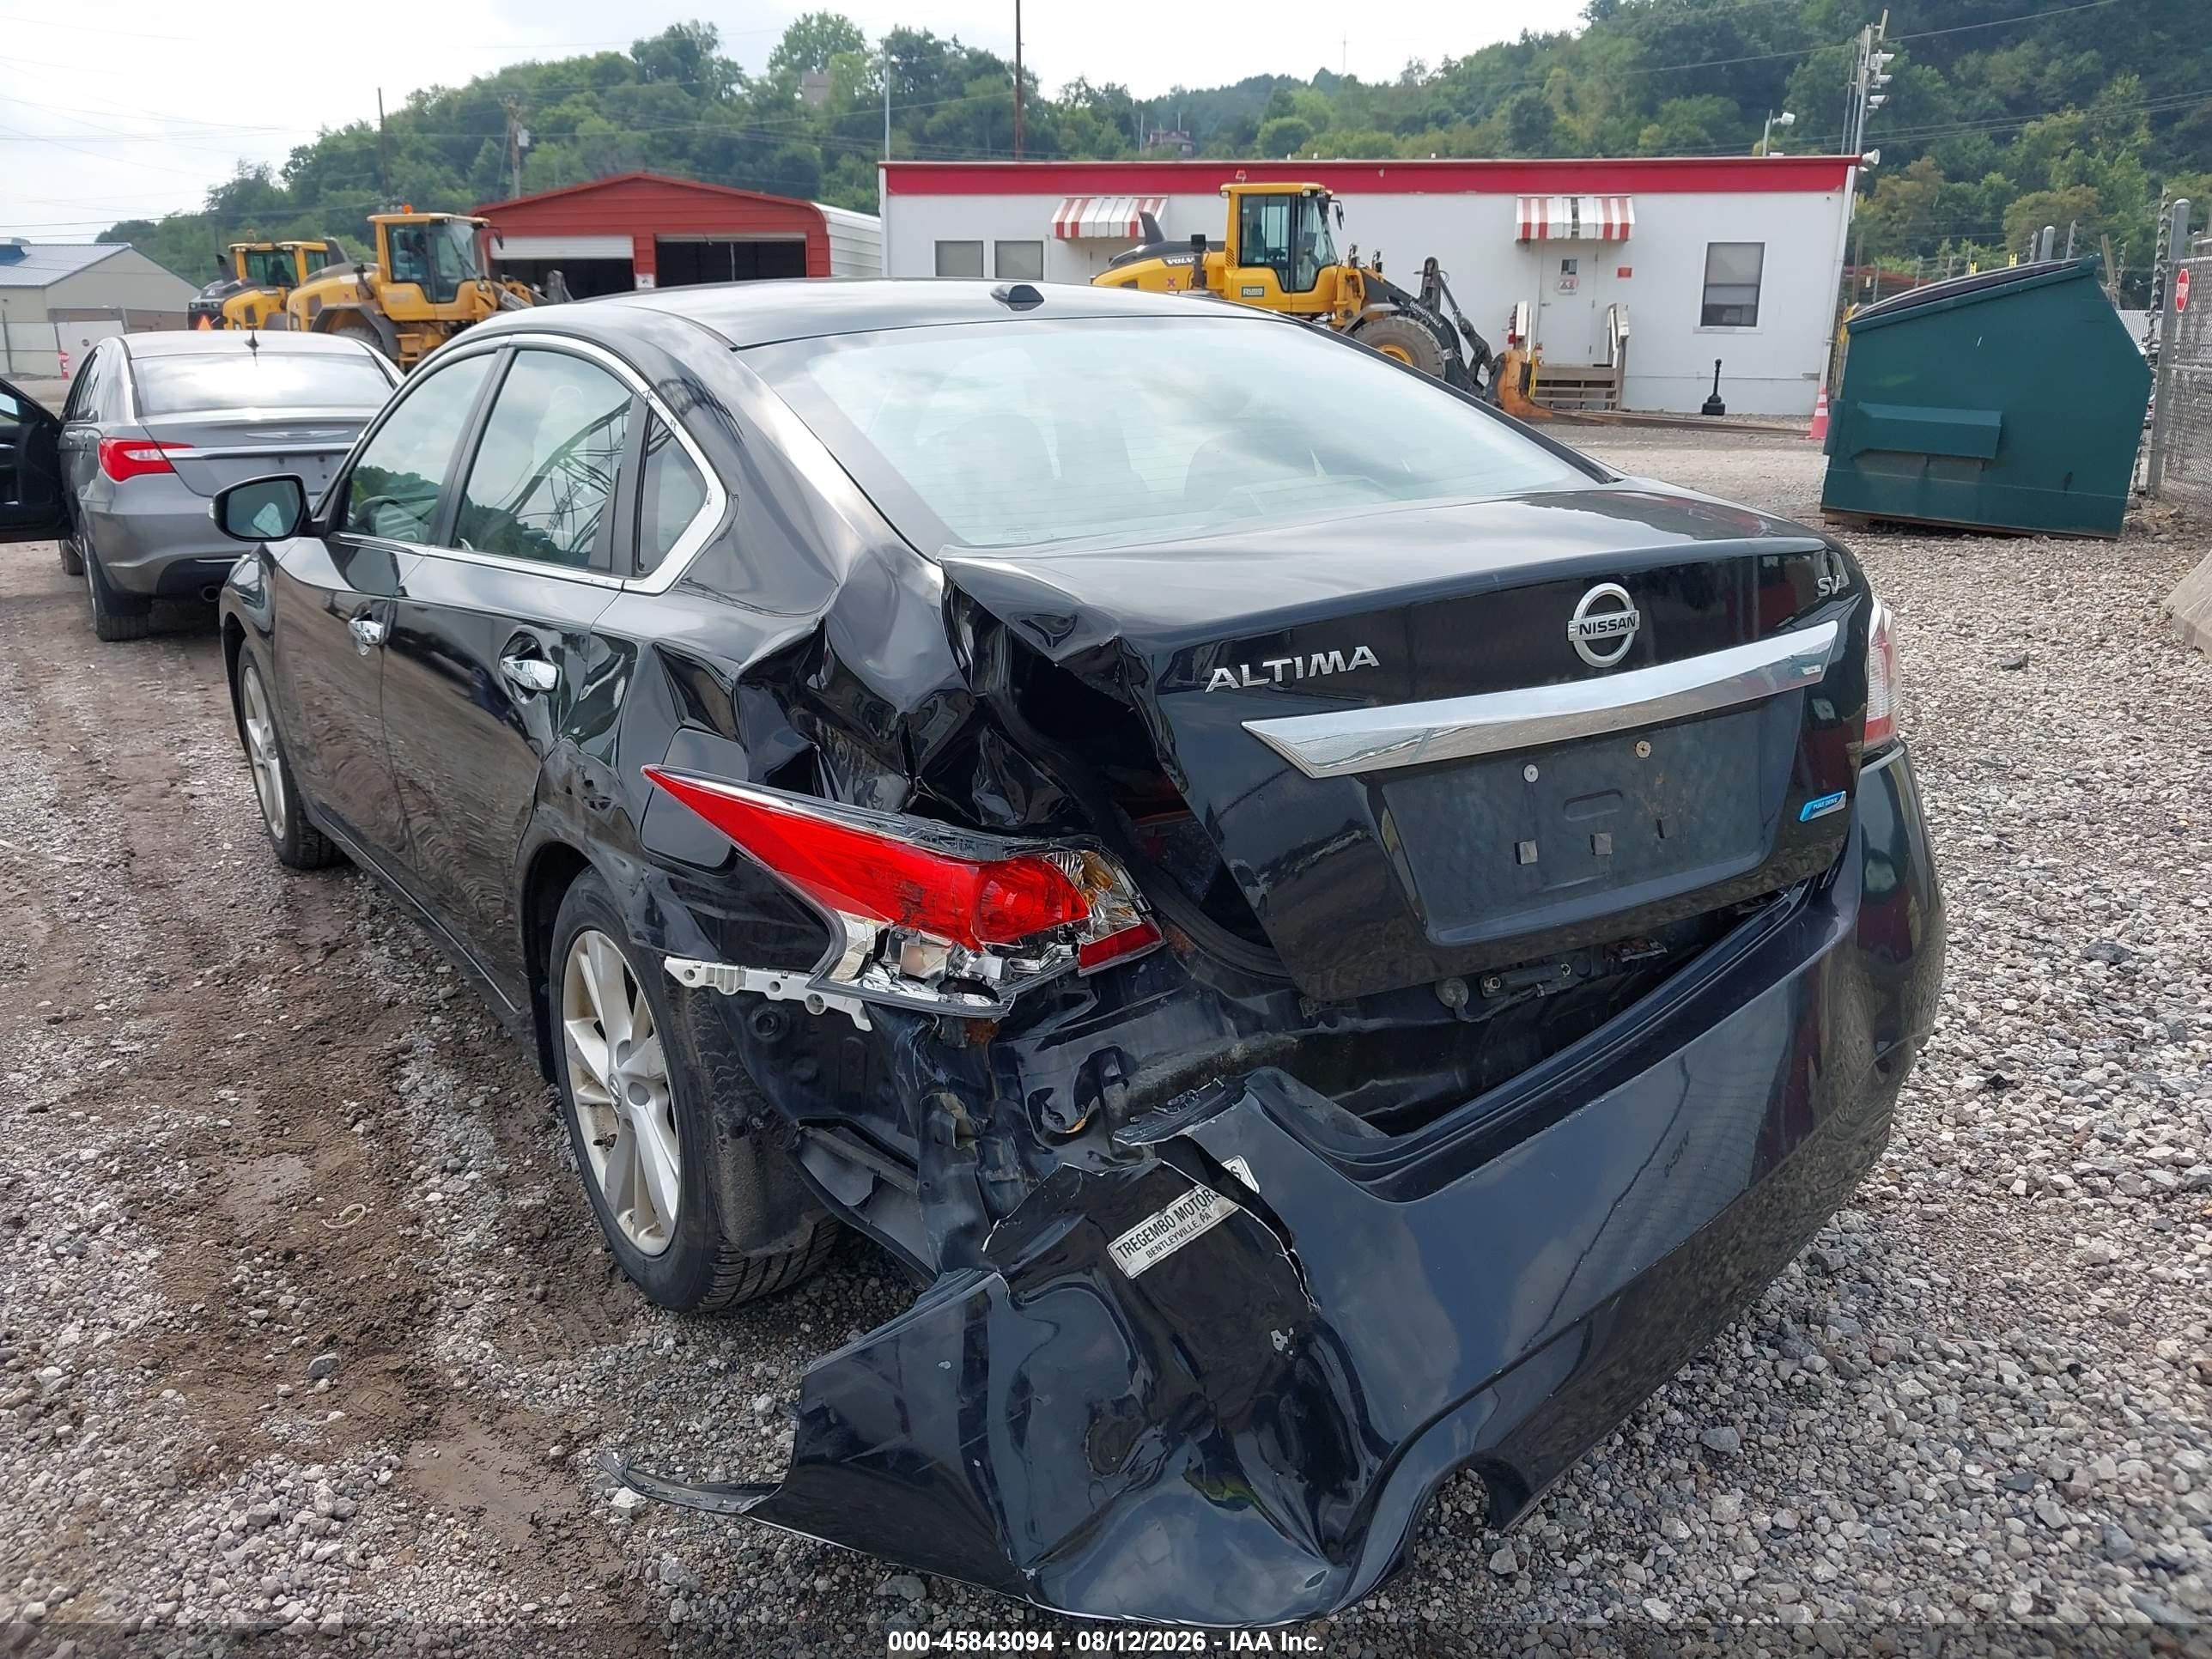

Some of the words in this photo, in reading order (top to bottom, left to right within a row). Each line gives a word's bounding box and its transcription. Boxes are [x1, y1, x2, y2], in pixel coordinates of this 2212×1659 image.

[2176, 283, 2189, 299] STOP
[1817, 574, 1840, 597] SV
[1579, 616, 1636, 635] NISSAN
[1205, 646, 1381, 693] ALTIMA
[1115, 1214, 1176, 1259] TREGEMBO
[1146, 1219, 1202, 1259] BENTLEYVILLE,
[1200, 1212, 1213, 1224] PA
